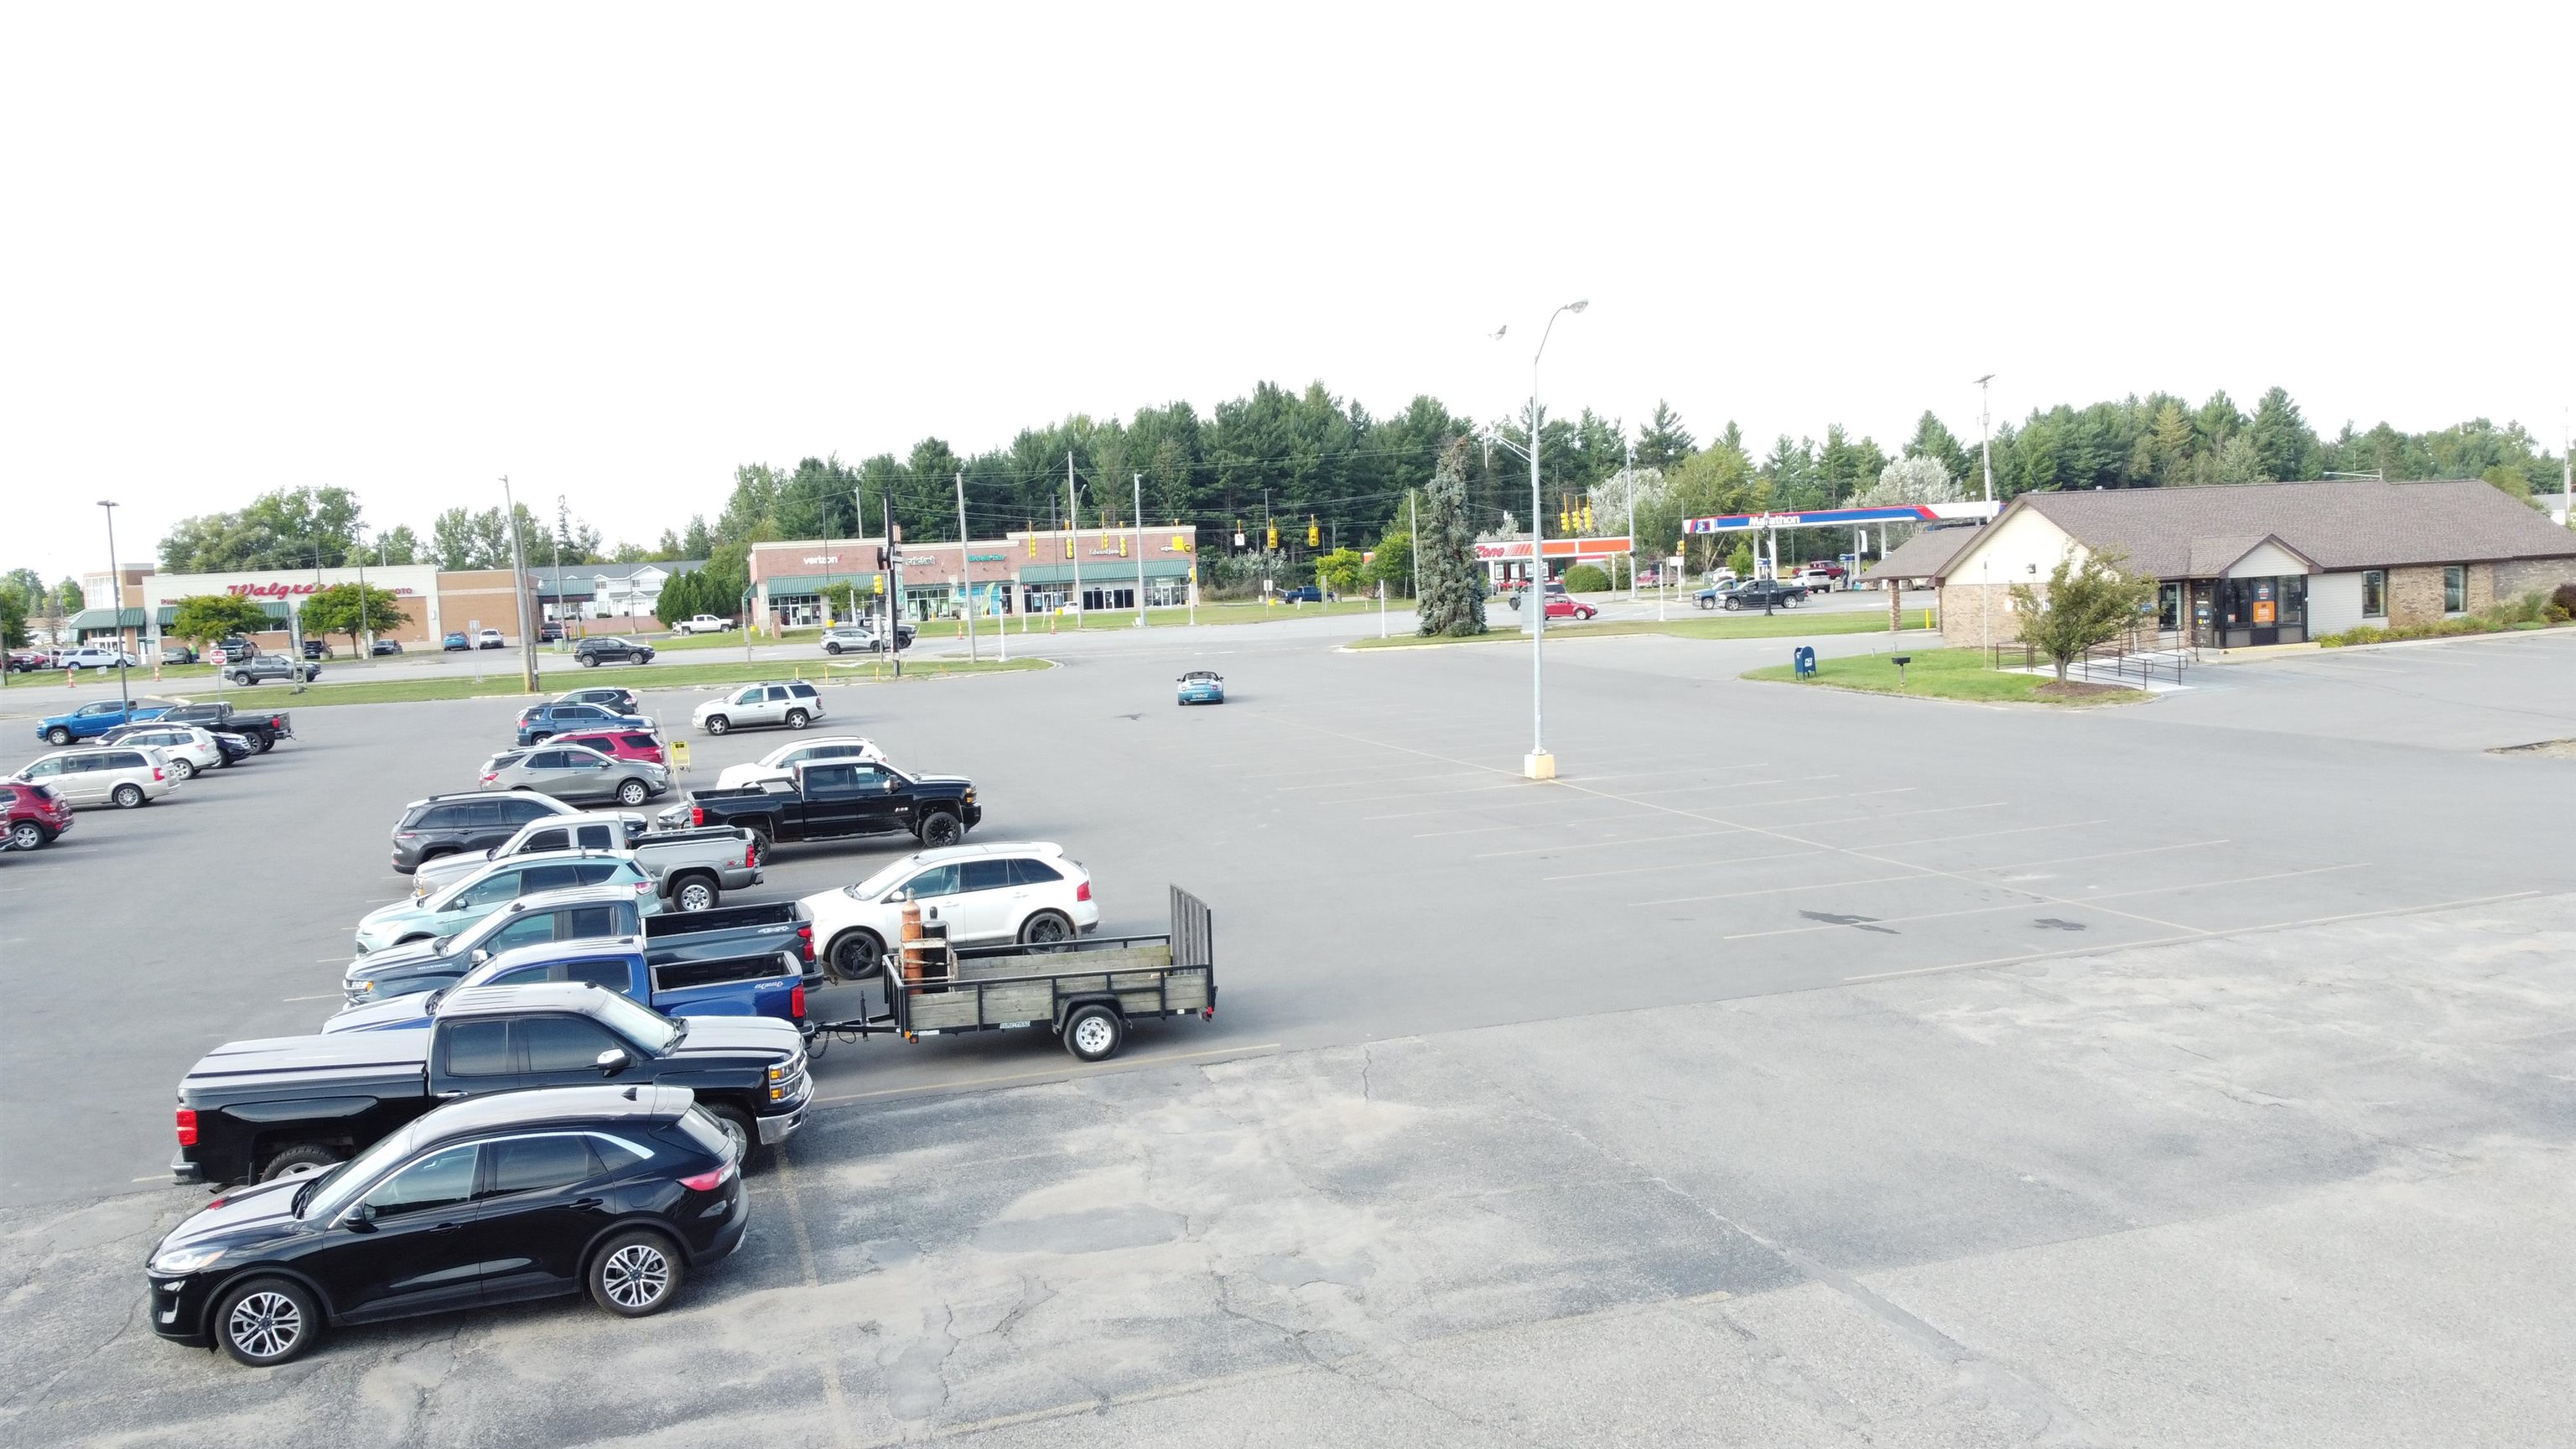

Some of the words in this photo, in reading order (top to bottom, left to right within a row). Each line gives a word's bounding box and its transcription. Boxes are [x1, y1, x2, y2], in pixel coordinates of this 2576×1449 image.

[803, 555, 839, 564] verizon
[906, 556, 935, 565] cricket
[226, 582, 335, 600] Walgre
